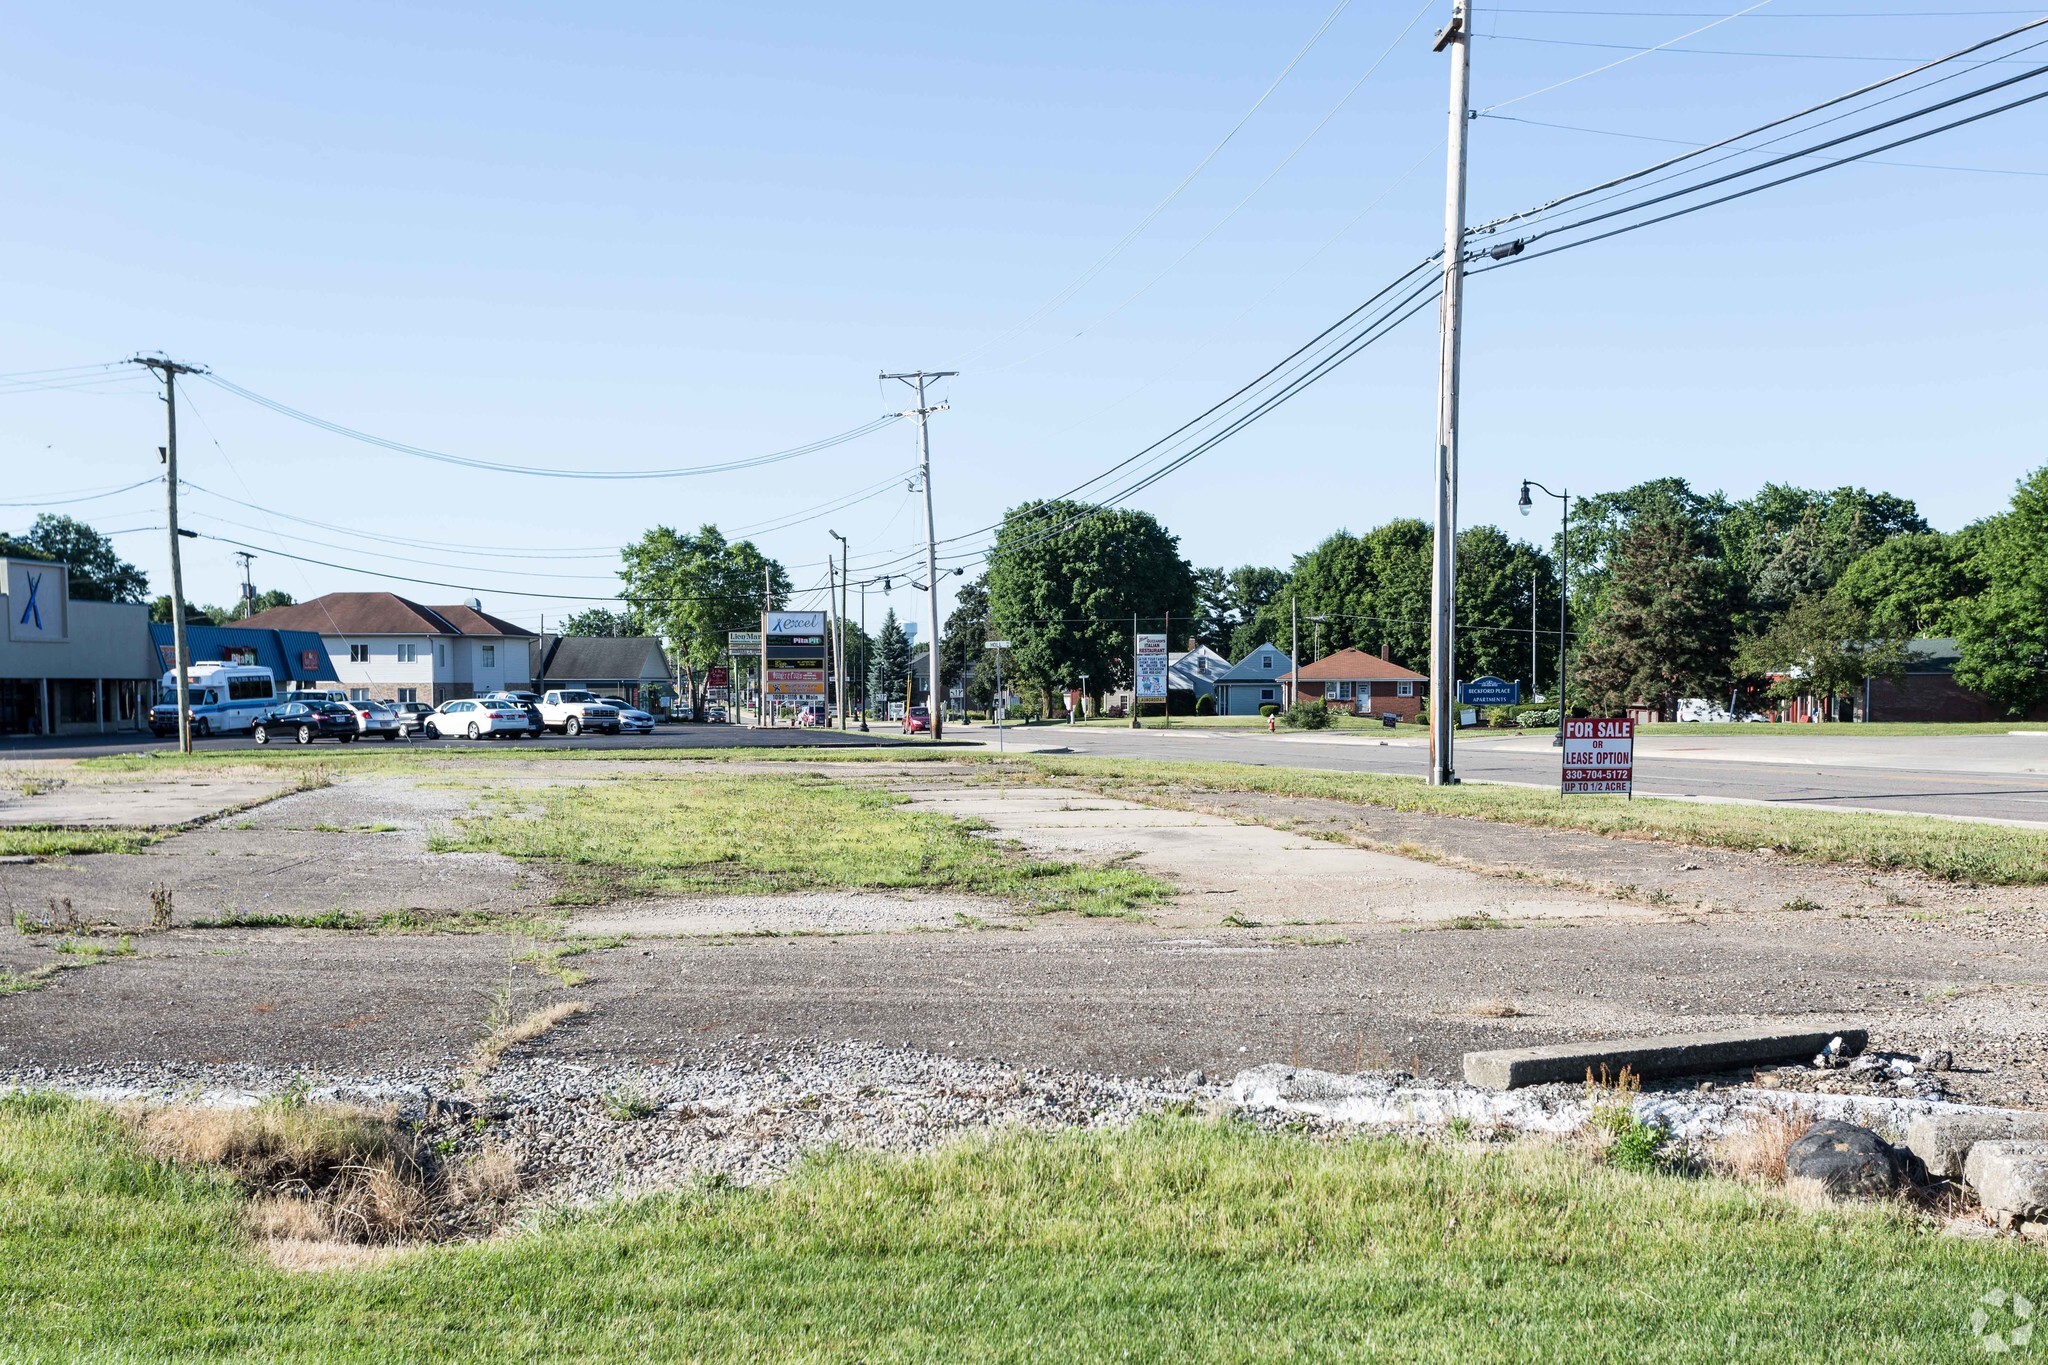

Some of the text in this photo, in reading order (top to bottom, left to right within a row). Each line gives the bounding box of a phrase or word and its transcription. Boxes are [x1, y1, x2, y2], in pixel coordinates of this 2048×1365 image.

[783, 614, 818, 629] excel
[1567, 721, 1631, 738] FOR SALE
[1592, 740, 1603, 748] OR
[1566, 751, 1629, 765] LEASE OPTION
[1566, 770, 1628, 779] 330-704-5172
[1564, 782, 1627, 791] UP TO 1/2 ACRE
